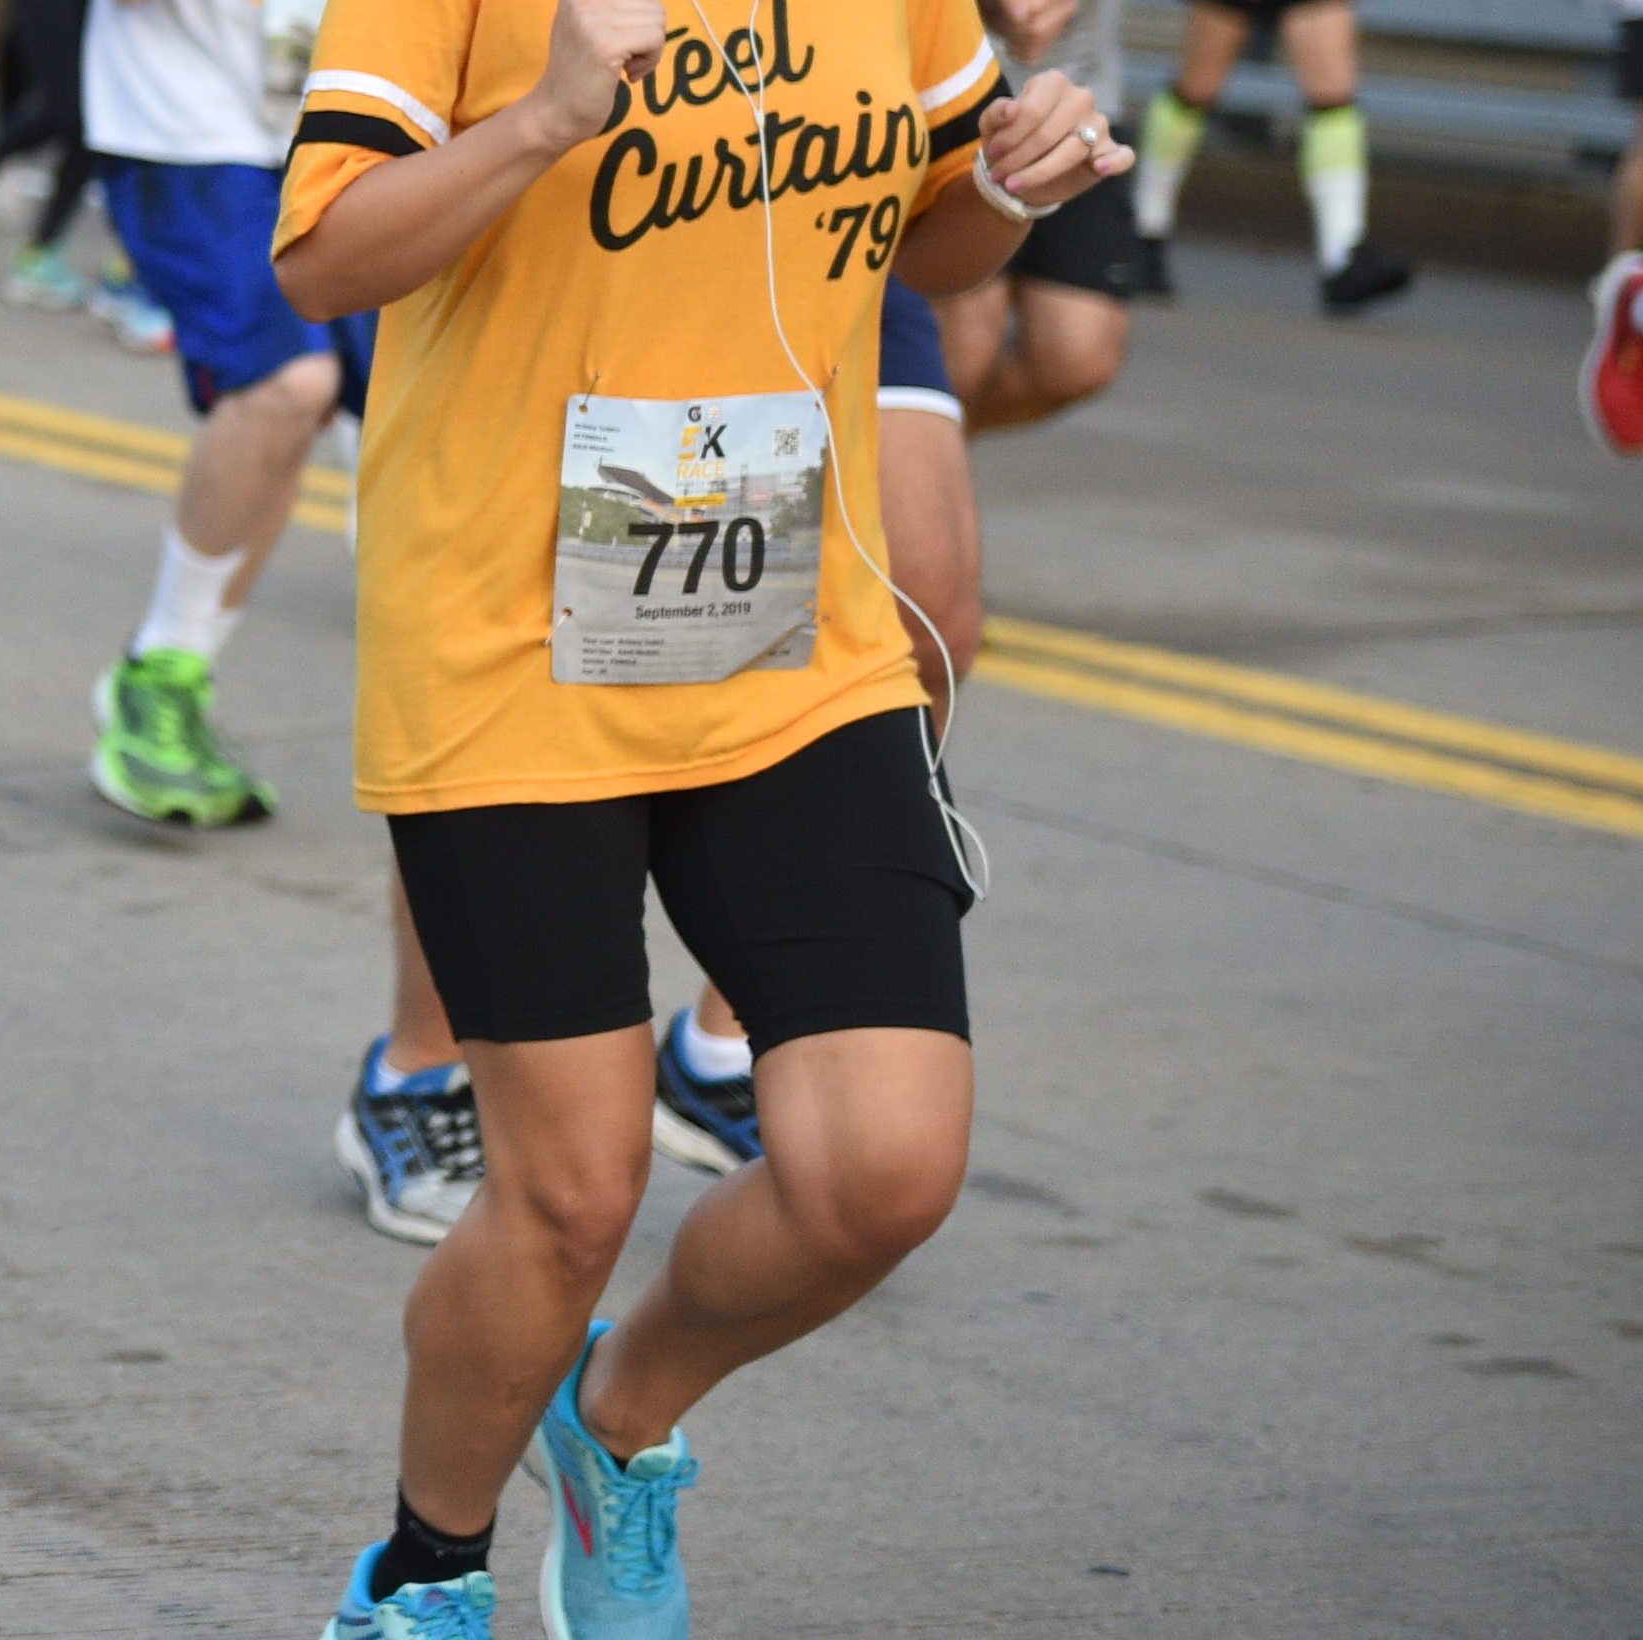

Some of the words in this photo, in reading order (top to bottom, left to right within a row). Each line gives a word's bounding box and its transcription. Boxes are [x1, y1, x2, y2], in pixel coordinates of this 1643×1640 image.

[589, 90, 930, 252] Curtain
[678, 424, 727, 460] 5K
[627, 516, 765, 596] 770
[635, 604, 703, 621] September
[721, 601, 752, 616] 2019
